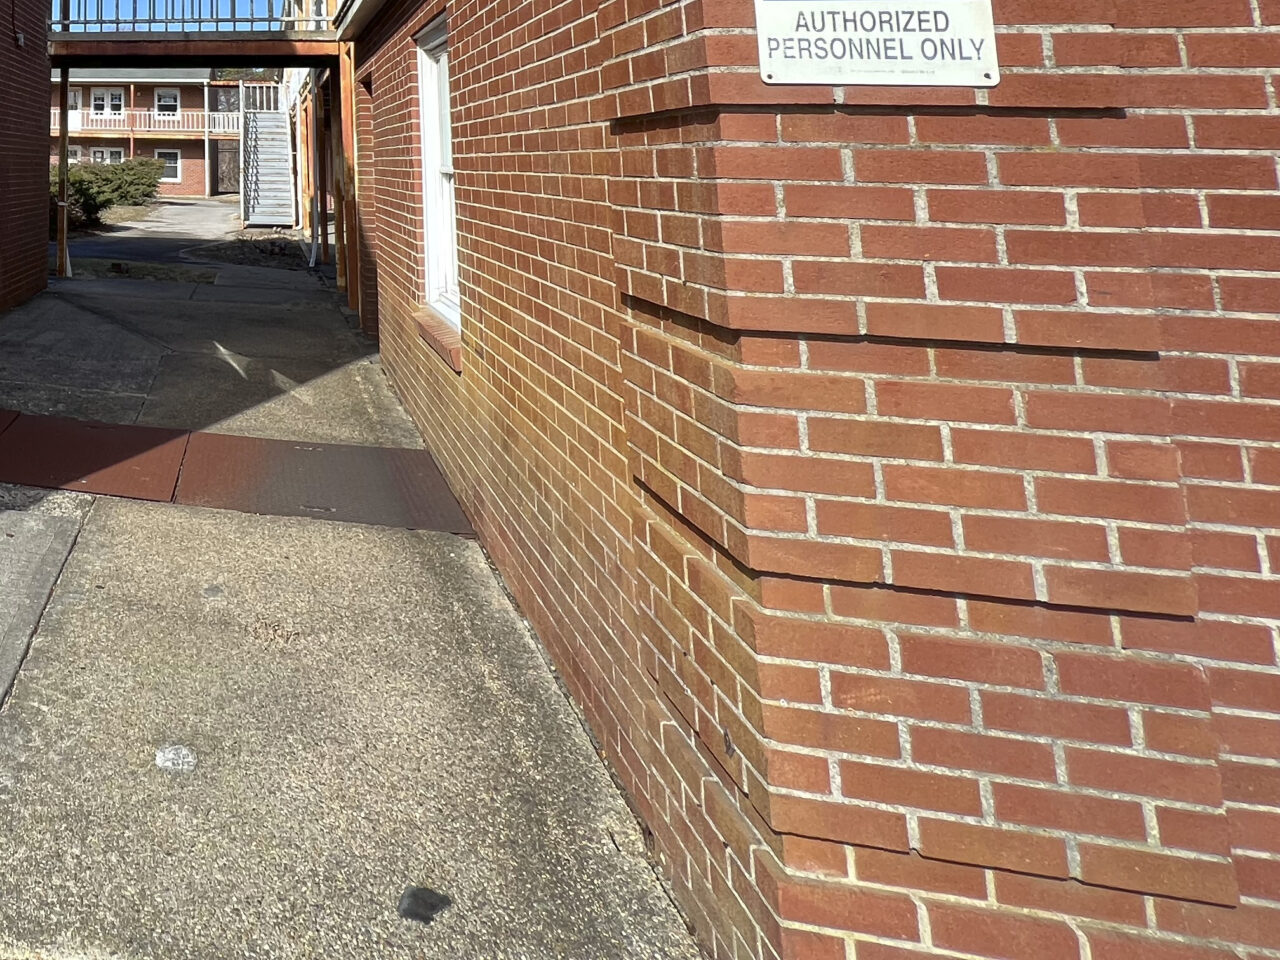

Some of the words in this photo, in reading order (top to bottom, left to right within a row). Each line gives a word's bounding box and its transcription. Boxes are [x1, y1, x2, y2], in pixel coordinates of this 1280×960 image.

[795, 10, 950, 33] AUTHORIZED
[767, 37, 913, 60] PERSONNEL
[920, 38, 985, 61] ONLY
